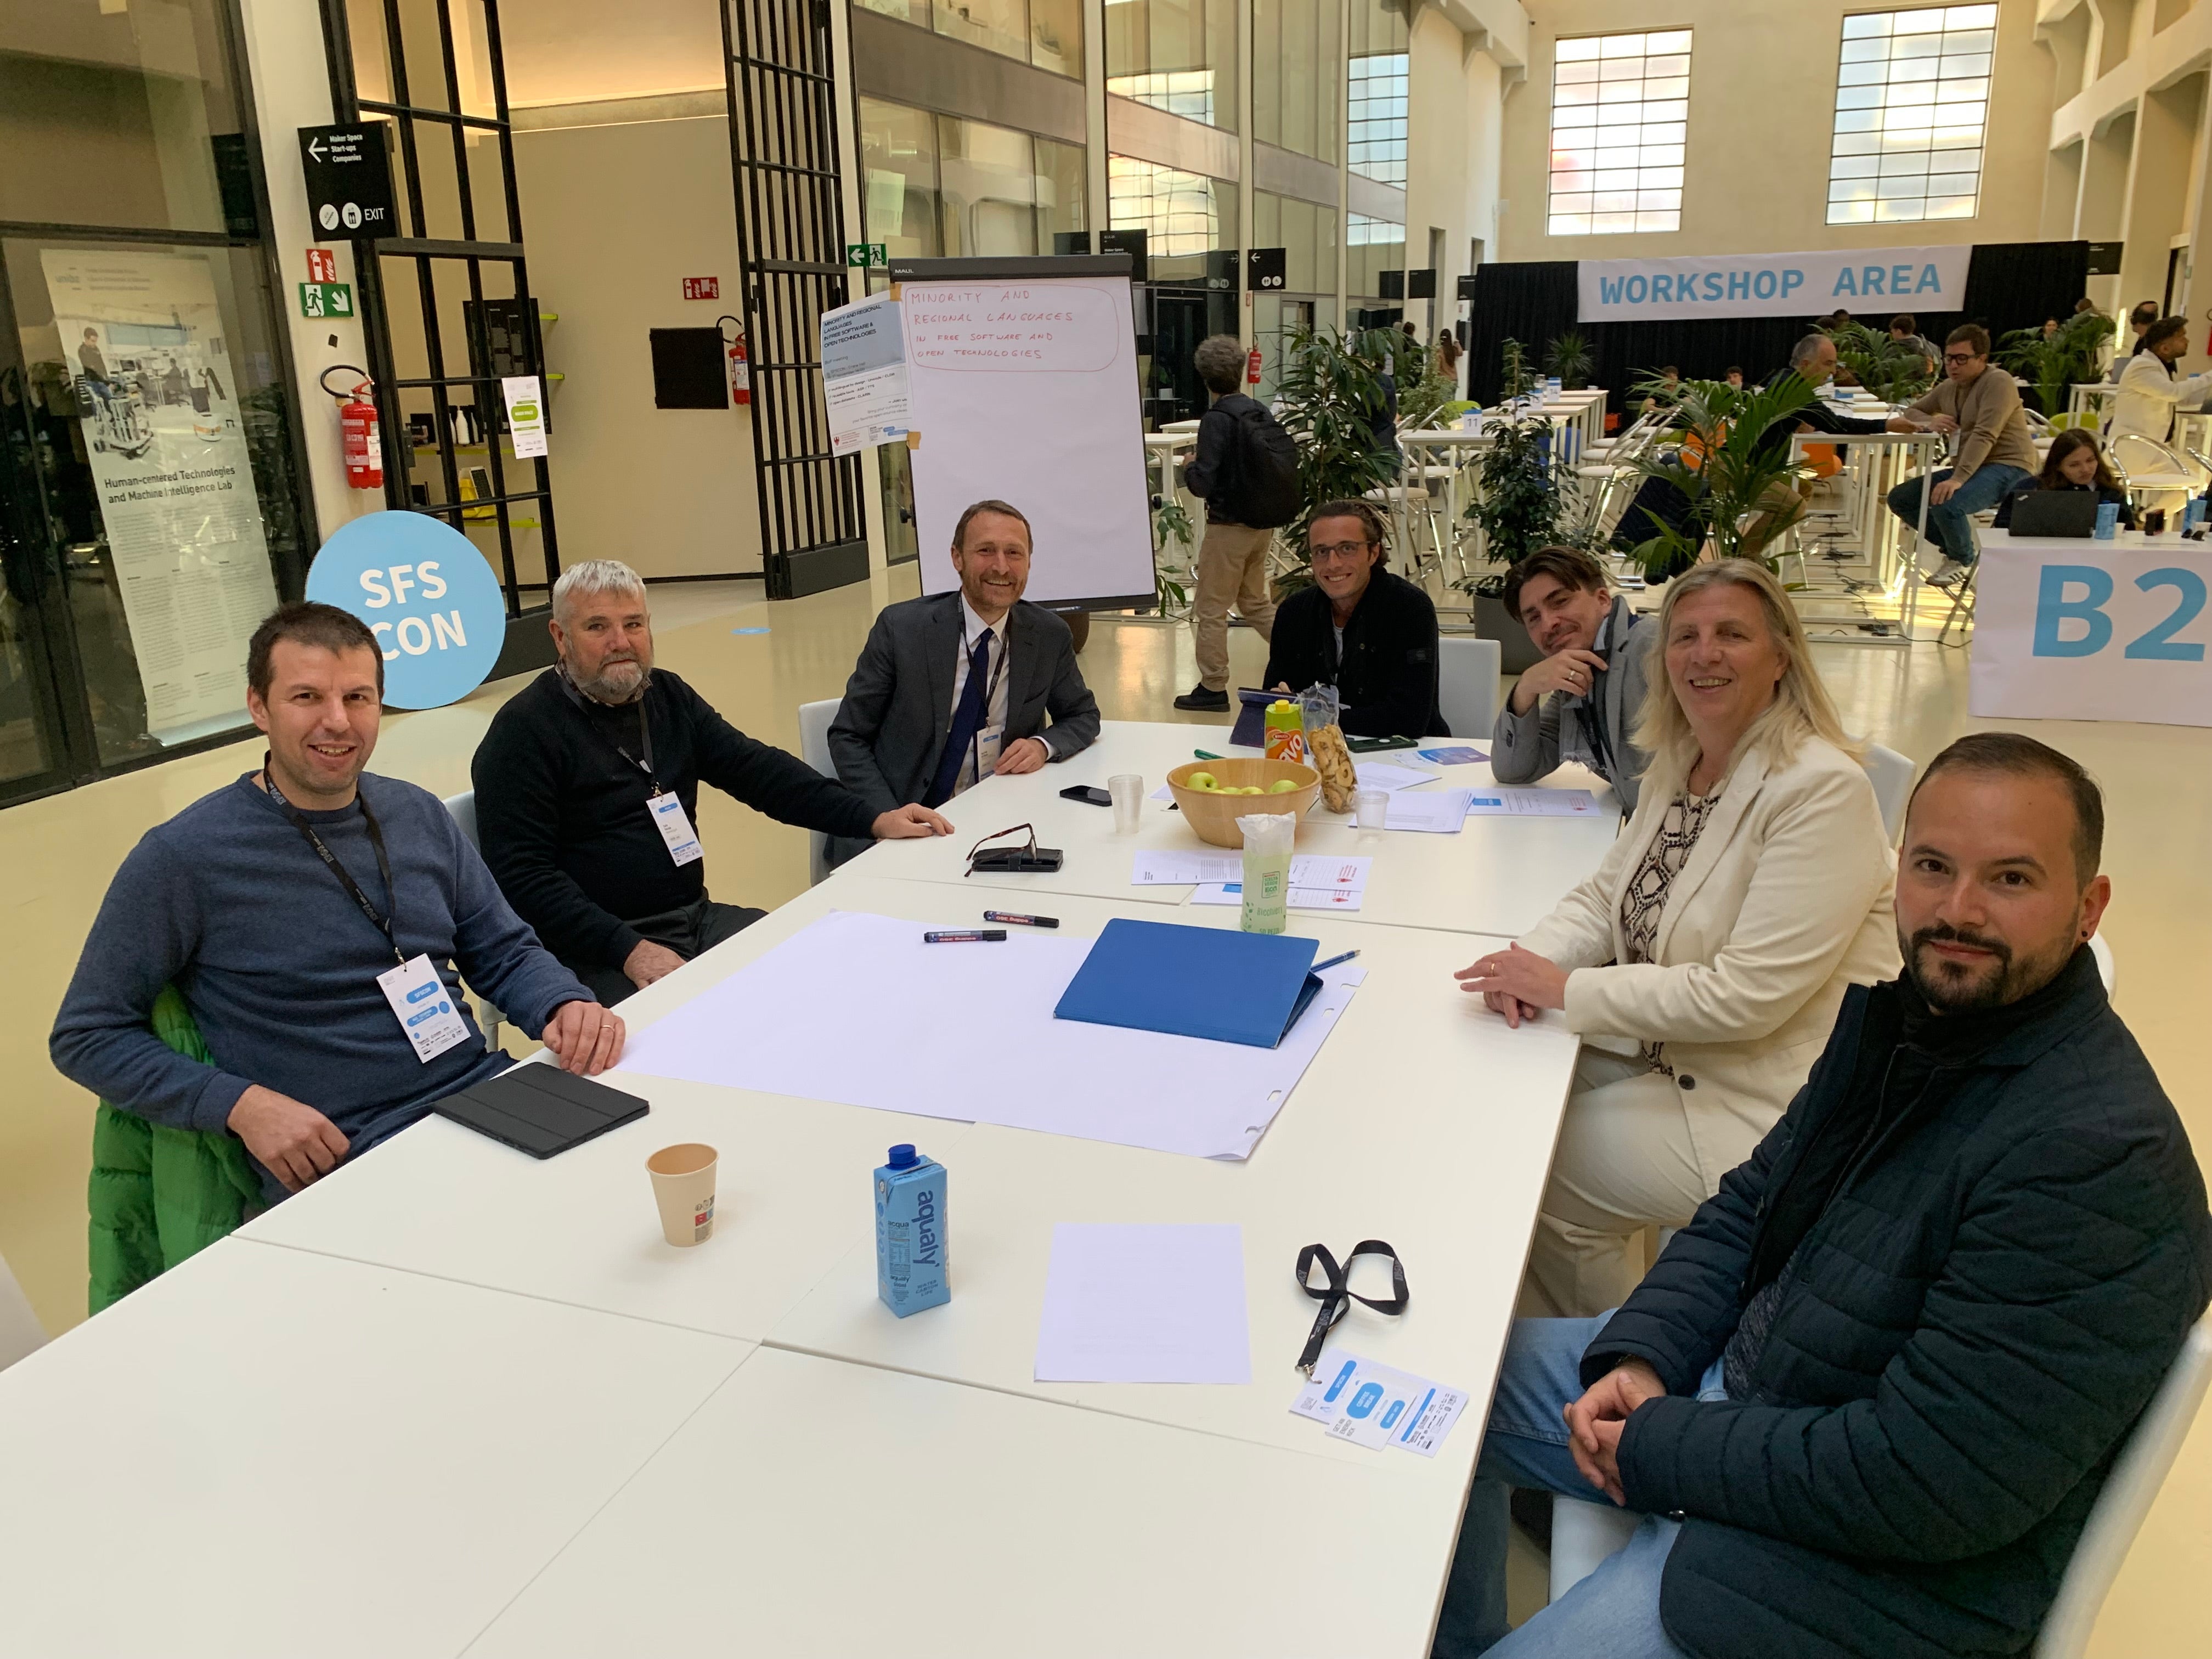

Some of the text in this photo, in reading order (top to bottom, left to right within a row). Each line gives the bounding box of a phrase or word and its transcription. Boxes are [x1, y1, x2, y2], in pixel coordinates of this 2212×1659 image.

[332, 154, 362, 162] Companies
[364, 208, 384, 221] EXIT
[1600, 263, 1942, 304] WORKSHOP AREA
[912, 291, 1029, 304] MINORITY AND
[824, 317, 845, 326] MINORITY
[856, 304, 882, 315] REGIONAL
[915, 312, 1073, 325] REGIONAL LANGUAGES
[824, 321, 852, 334] LANGUAGES
[842, 324, 870, 336] SOFTWARE
[838, 329, 877, 343] TECHNOLOGIES
[954, 349, 1041, 359] TECHNOLOGIES
[1467, 418, 1478, 427] 11
[104, 466, 235, 488] Human-centered Technologies
[109, 480, 233, 503] and Machine Intelligence Lab
[359, 561, 447, 608] SFS
[2033, 565, 2207, 662] B2
[370, 610, 467, 661] CON
[888, 1220, 909, 1228] acqua
